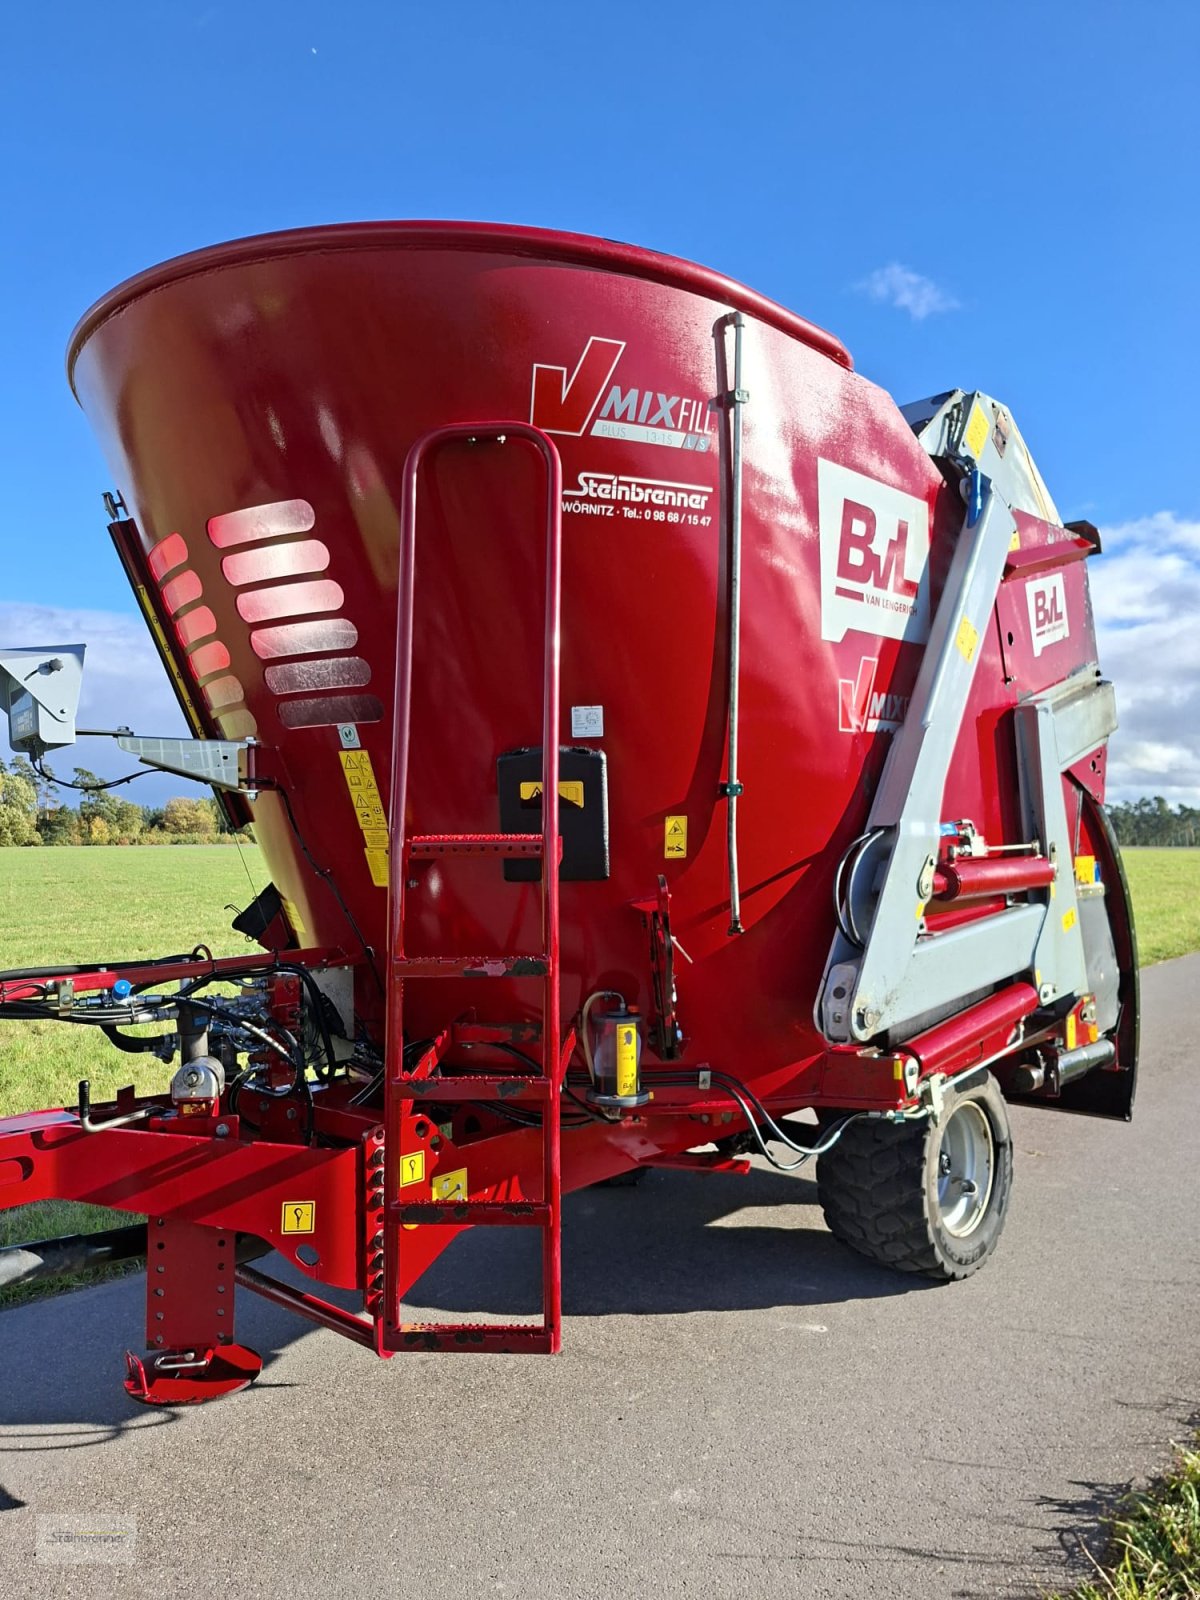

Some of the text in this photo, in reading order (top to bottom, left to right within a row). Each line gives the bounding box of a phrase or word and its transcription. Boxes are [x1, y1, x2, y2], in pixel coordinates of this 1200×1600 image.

[601, 424, 626, 438] PLUS
[562, 472, 713, 510] Steinbrenner
[561, 501, 614, 517] WÖRNITZ
[623, 507, 642, 519] Tel.:
[644, 509, 651, 520] 0
[653, 511, 664, 521] 98
[667, 512, 679, 523] 68
[687, 515, 699, 525] 15
[700, 516, 711, 527] 47
[865, 594, 880, 607] VAN
